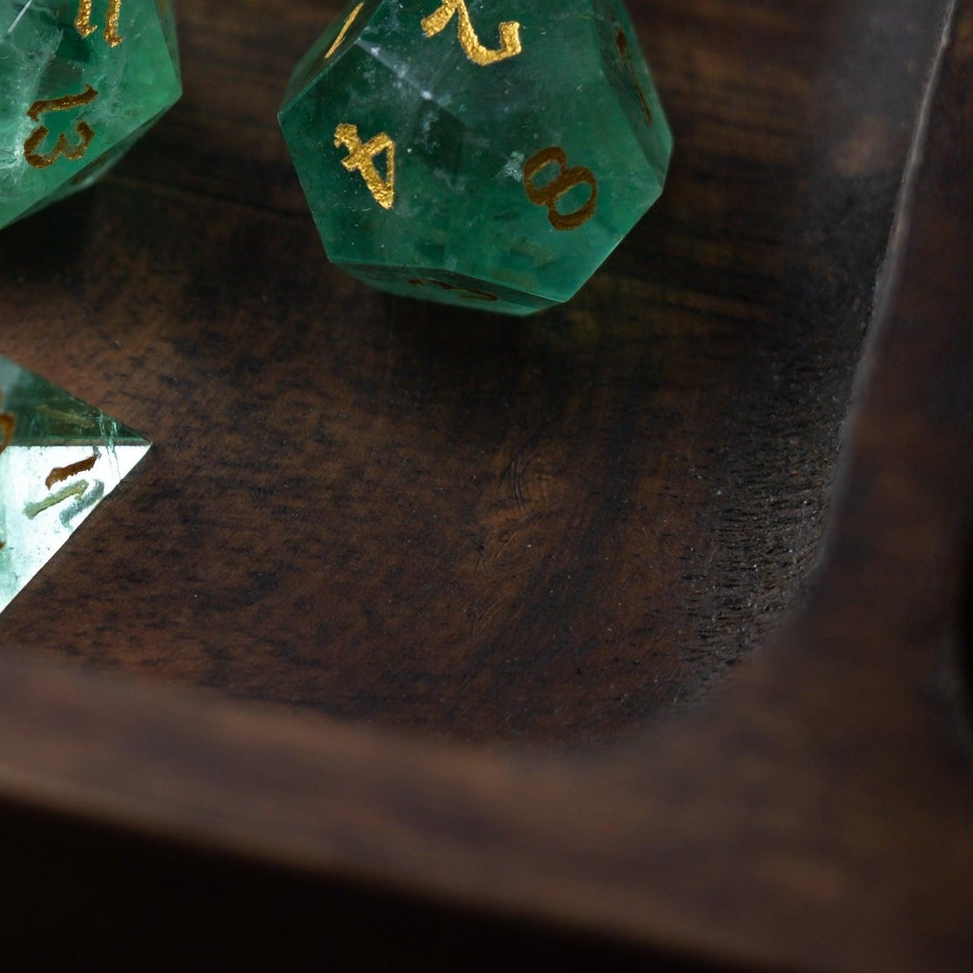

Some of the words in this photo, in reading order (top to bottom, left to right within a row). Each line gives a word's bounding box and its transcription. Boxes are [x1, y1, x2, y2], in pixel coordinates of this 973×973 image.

[23, 84, 98, 169] 13
[333, 123, 396, 210] 4
[523, 146, 597, 231] 8
